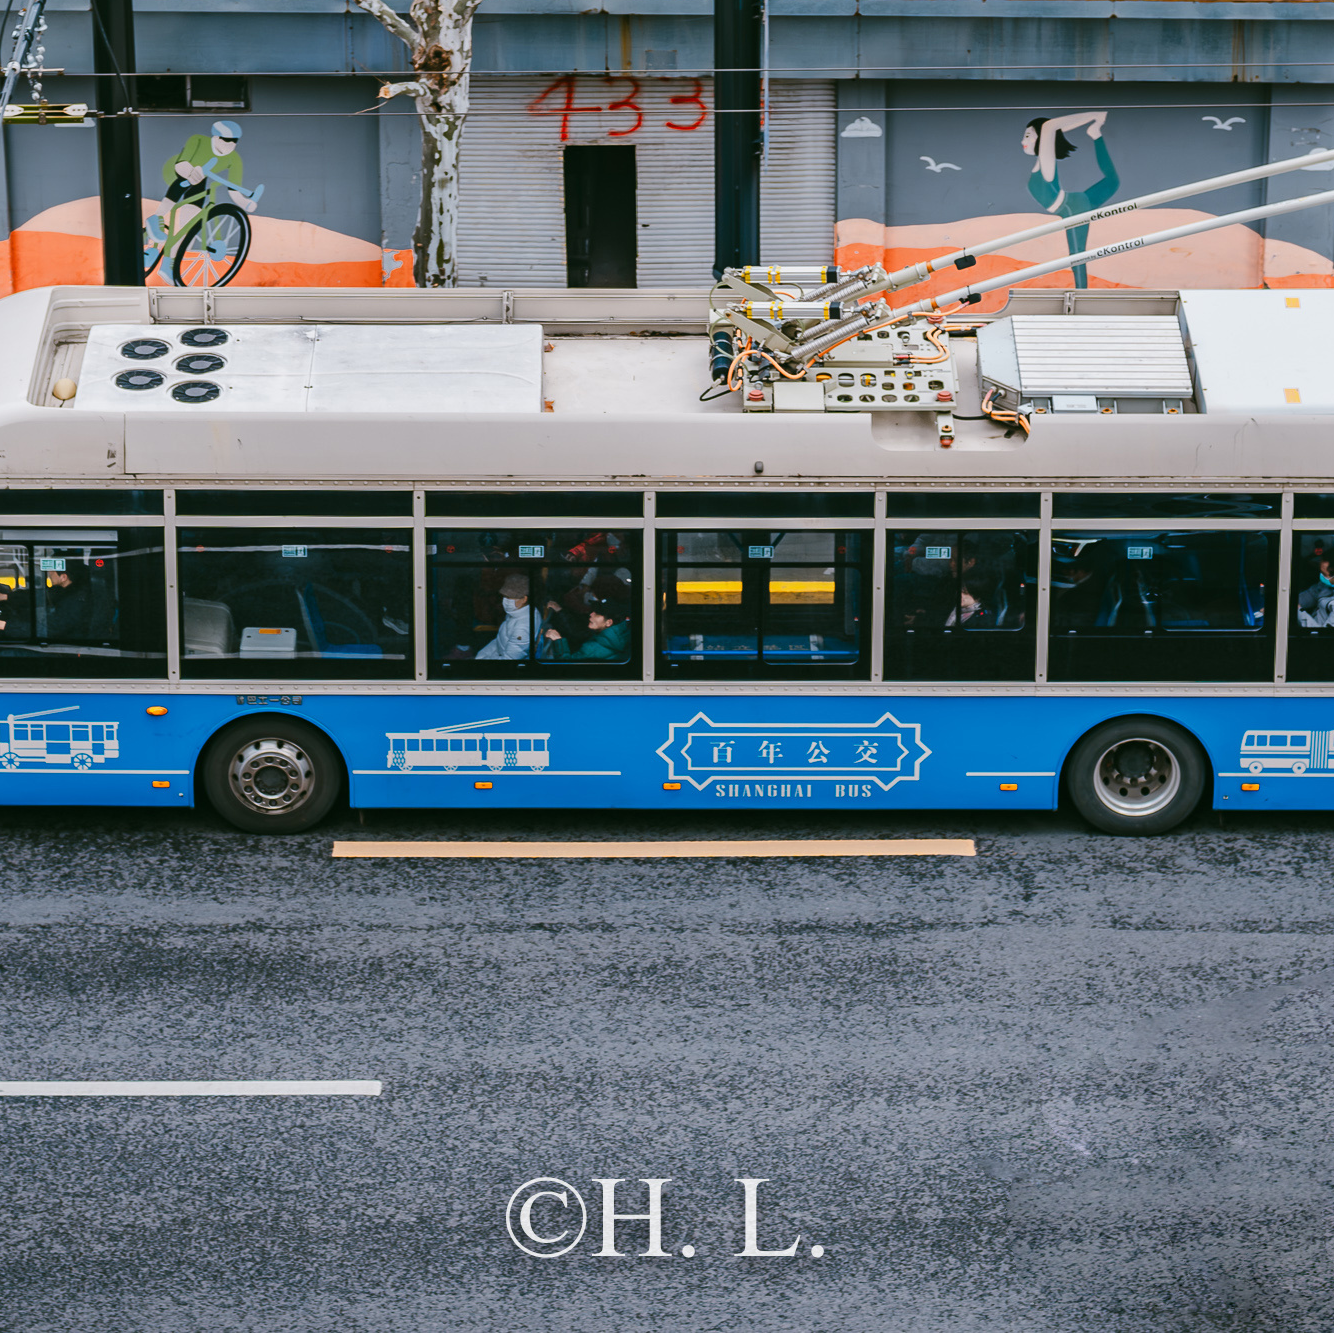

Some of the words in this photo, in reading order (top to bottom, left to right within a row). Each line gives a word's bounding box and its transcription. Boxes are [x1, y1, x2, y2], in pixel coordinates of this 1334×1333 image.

[1090, 202, 1138, 222] eKontrol
[1096, 237, 1145, 257] eKontrol
[710, 740, 879, 764] 百年公交
[715, 784, 812, 798] SHANGHAI
[835, 784, 872, 798] BUS
